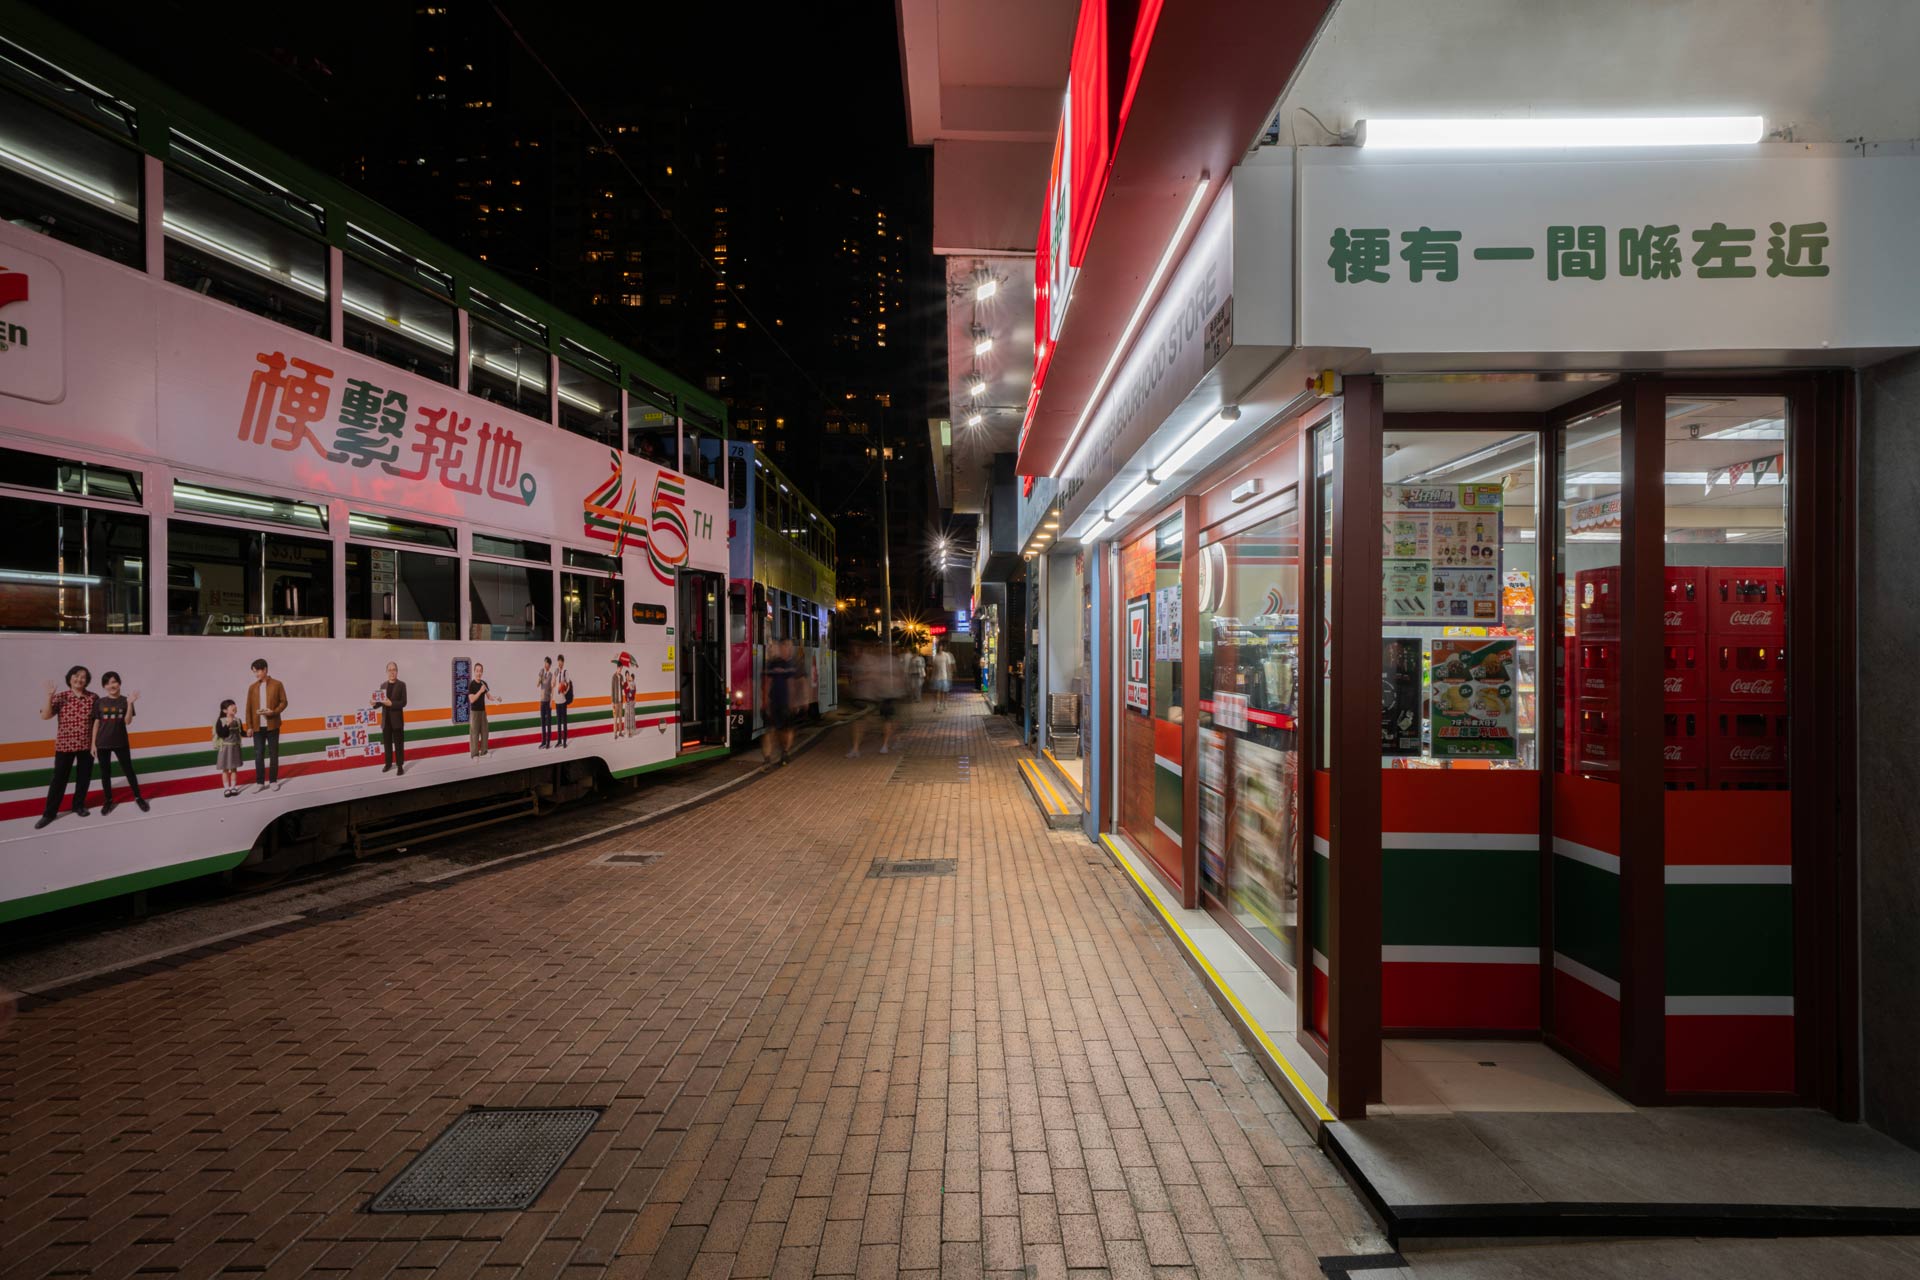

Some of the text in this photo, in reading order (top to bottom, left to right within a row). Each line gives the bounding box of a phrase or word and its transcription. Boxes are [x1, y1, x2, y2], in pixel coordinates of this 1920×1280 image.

[1327, 221, 1830, 284] 梗有一間喺左近
[1168, 262, 1217, 366] STORE
[731, 445, 745, 458] 78
[1729, 610, 1773, 626] Coca-Cola
[1729, 677, 1775, 694] Coca-Cola
[1729, 744, 1775, 762] Coca-Cola
